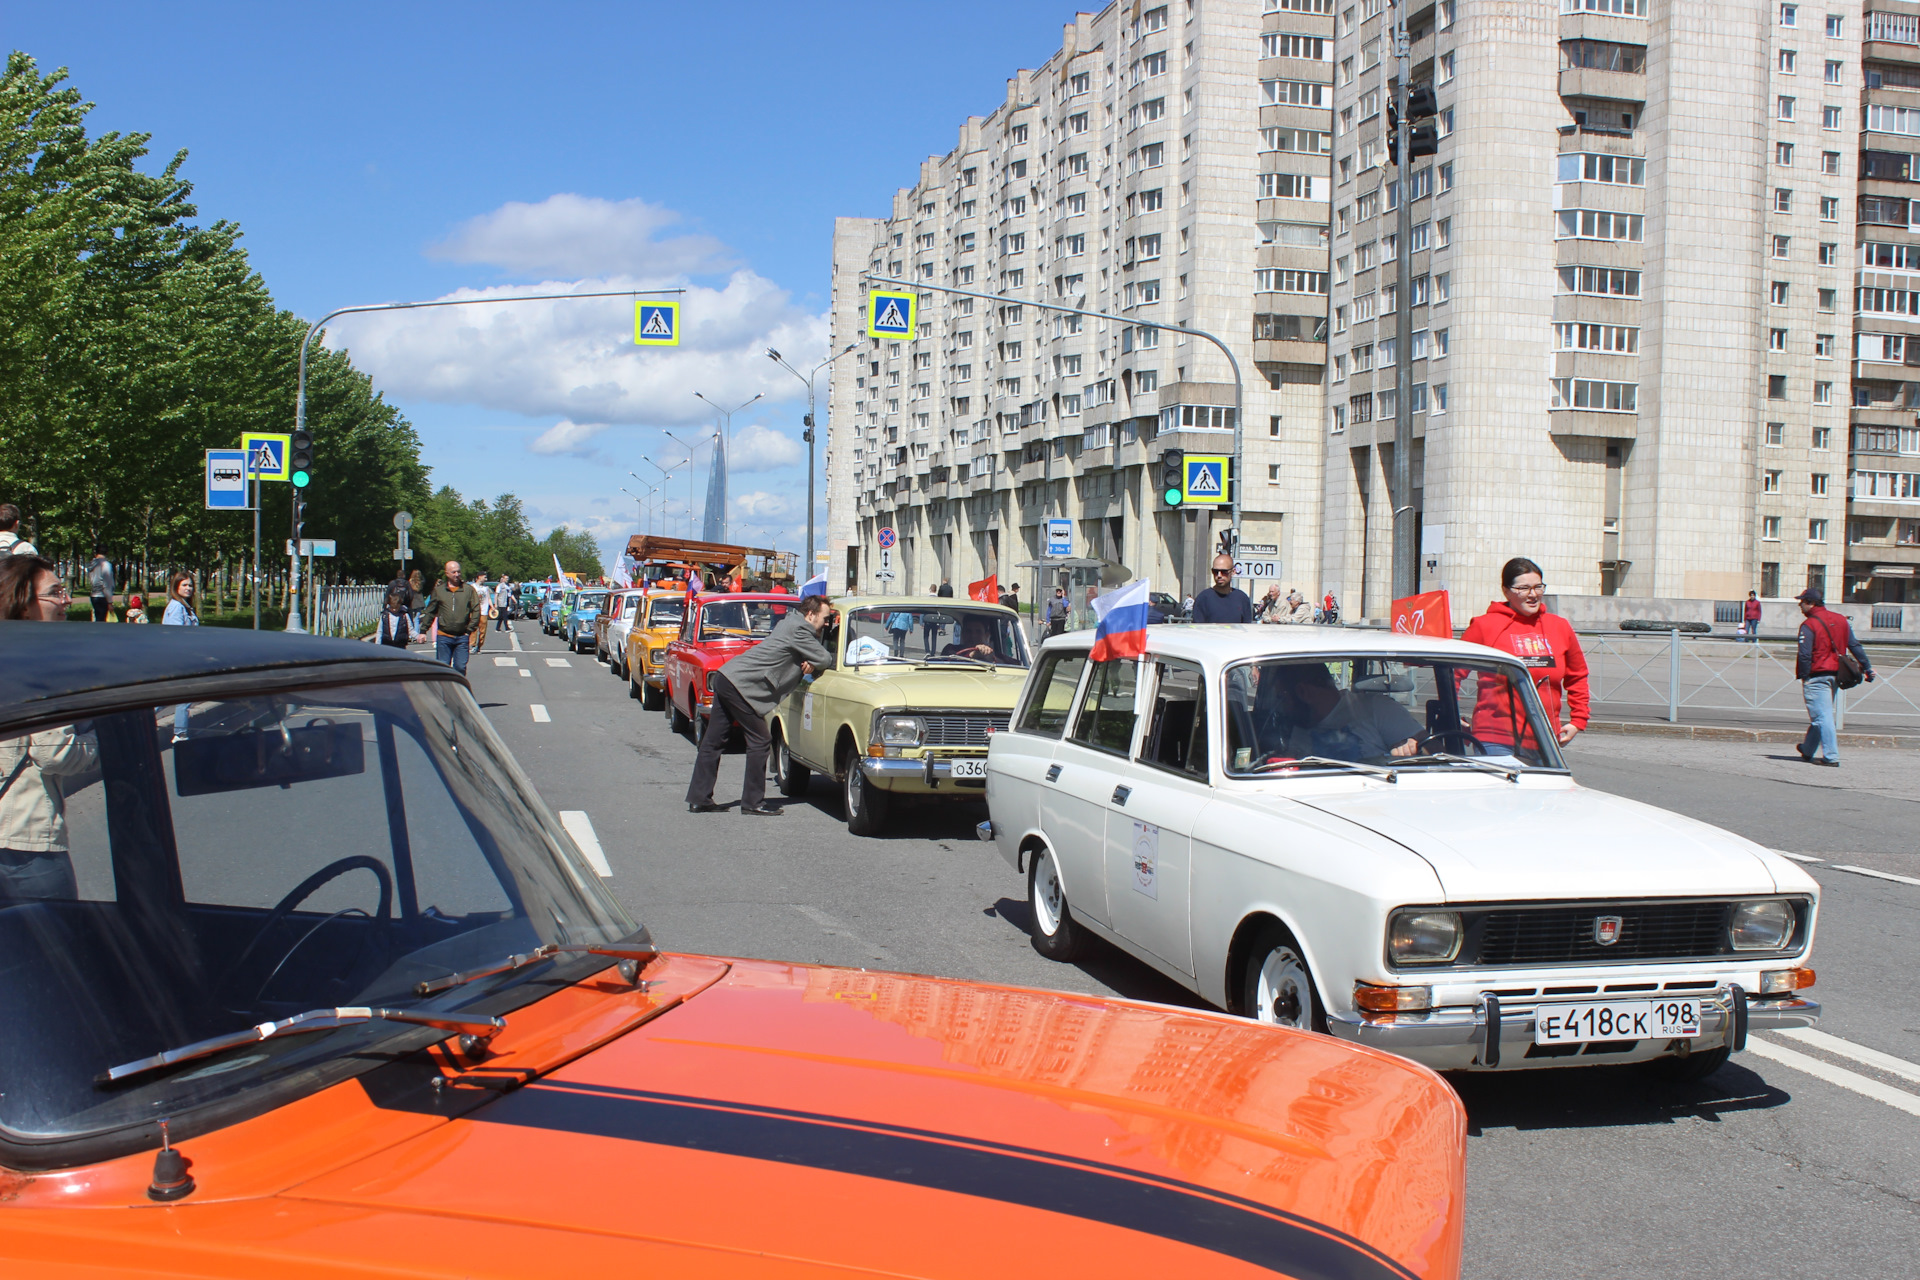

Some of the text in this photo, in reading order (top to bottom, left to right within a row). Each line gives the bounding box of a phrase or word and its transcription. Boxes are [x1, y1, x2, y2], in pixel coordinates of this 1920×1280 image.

[1234, 562, 1274, 576] СТОП
[1547, 1003, 1694, 1039] Е418СК 198
[1662, 1026, 1682, 1034] RUS
